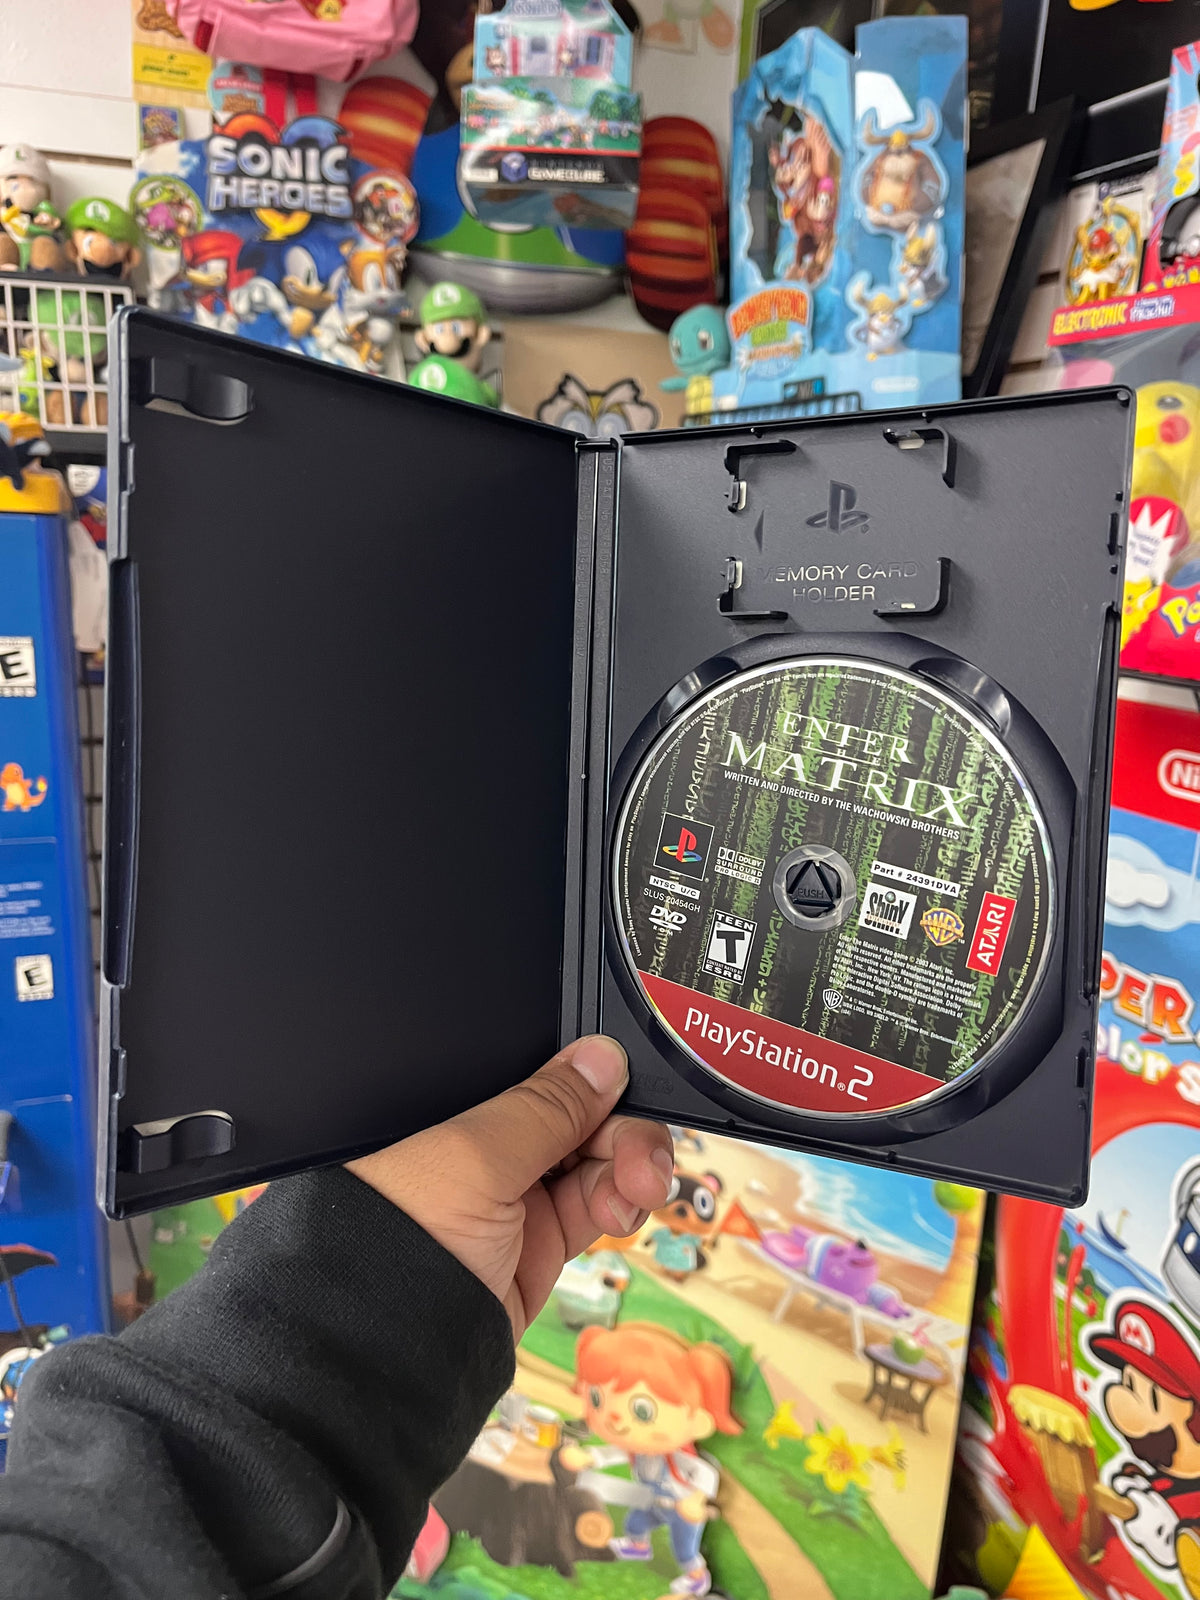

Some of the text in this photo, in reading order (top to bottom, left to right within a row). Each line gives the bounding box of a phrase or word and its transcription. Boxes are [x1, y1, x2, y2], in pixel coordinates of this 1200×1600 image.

[207, 135, 350, 183] SONIC
[207, 177, 353, 219] HEROES
[1053, 302, 1126, 336] ELECTRONIC
[758, 563, 918, 584] MEMORY CARD
[793, 585, 875, 603] HOLDER
[0, 650, 28, 679] E
[782, 710, 914, 765] ENTER
[719, 730, 980, 830] MATRIX
[724, 770, 960, 840] WRITTEN AND DIRECTED BY THE WACHOWSKI BROTHERS
[715, 866, 729, 875] PRO
[731, 870, 749, 881] LOGIC
[716, 859, 764, 877] SURROUND
[737, 856, 763, 867] DOLBY
[652, 878, 698, 897] NTSC U/C
[797, 887, 825, 899] PUSH
[874, 863, 894, 876] Part
[906, 873, 957, 894] 24391DVA
[643, 887, 701, 912] SLUS 20454GH
[650, 904, 688, 925] DVD
[652, 925, 674, 937] ROM
[717, 912, 754, 932] TEEN
[976, 902, 1007, 968] ATARI
[716, 930, 745, 964] T
[861, 940, 879, 951] Matrix
[878, 946, 893, 956] video
[893, 951, 908, 961] game
[915, 957, 928, 967] 2003
[944, 967, 955, 975] Inc.
[24, 966, 47, 987] E
[705, 964, 742, 981] ESRB
[852, 953, 879, 967] respective
[879, 962, 900, 973] owners.
[899, 969, 935, 985] Manufactured
[935, 980, 946, 989] and
[945, 984, 971, 997] marketed
[859, 947, 883, 960] reserved.
[891, 958, 905, 967] other
[905, 963, 935, 977] trademarks
[944, 975, 954, 983] the
[953, 979, 976, 991] property
[844, 982, 876, 997] Laboratories.
[845, 966, 873, 980] Interactive
[872, 975, 890, 986] Digital
[889, 980, 913, 993] Software
[912, 989, 945, 1004] Association.
[855, 977, 866, 985] and
[865, 980, 874, 988] the
[897, 992, 917, 1004] symbol
[916, 998, 926, 1006] are
[926, 1001, 956, 1016] trademarks
[866, 966, 878, 974] New
[892, 974, 902, 982] NY.
[902, 977, 913, 985] The
[912, 980, 932, 993] ratings
[931, 987, 944, 996] icon
[953, 994, 982, 1008] trademark
[684, 1007, 874, 1101] PlayStation 2
